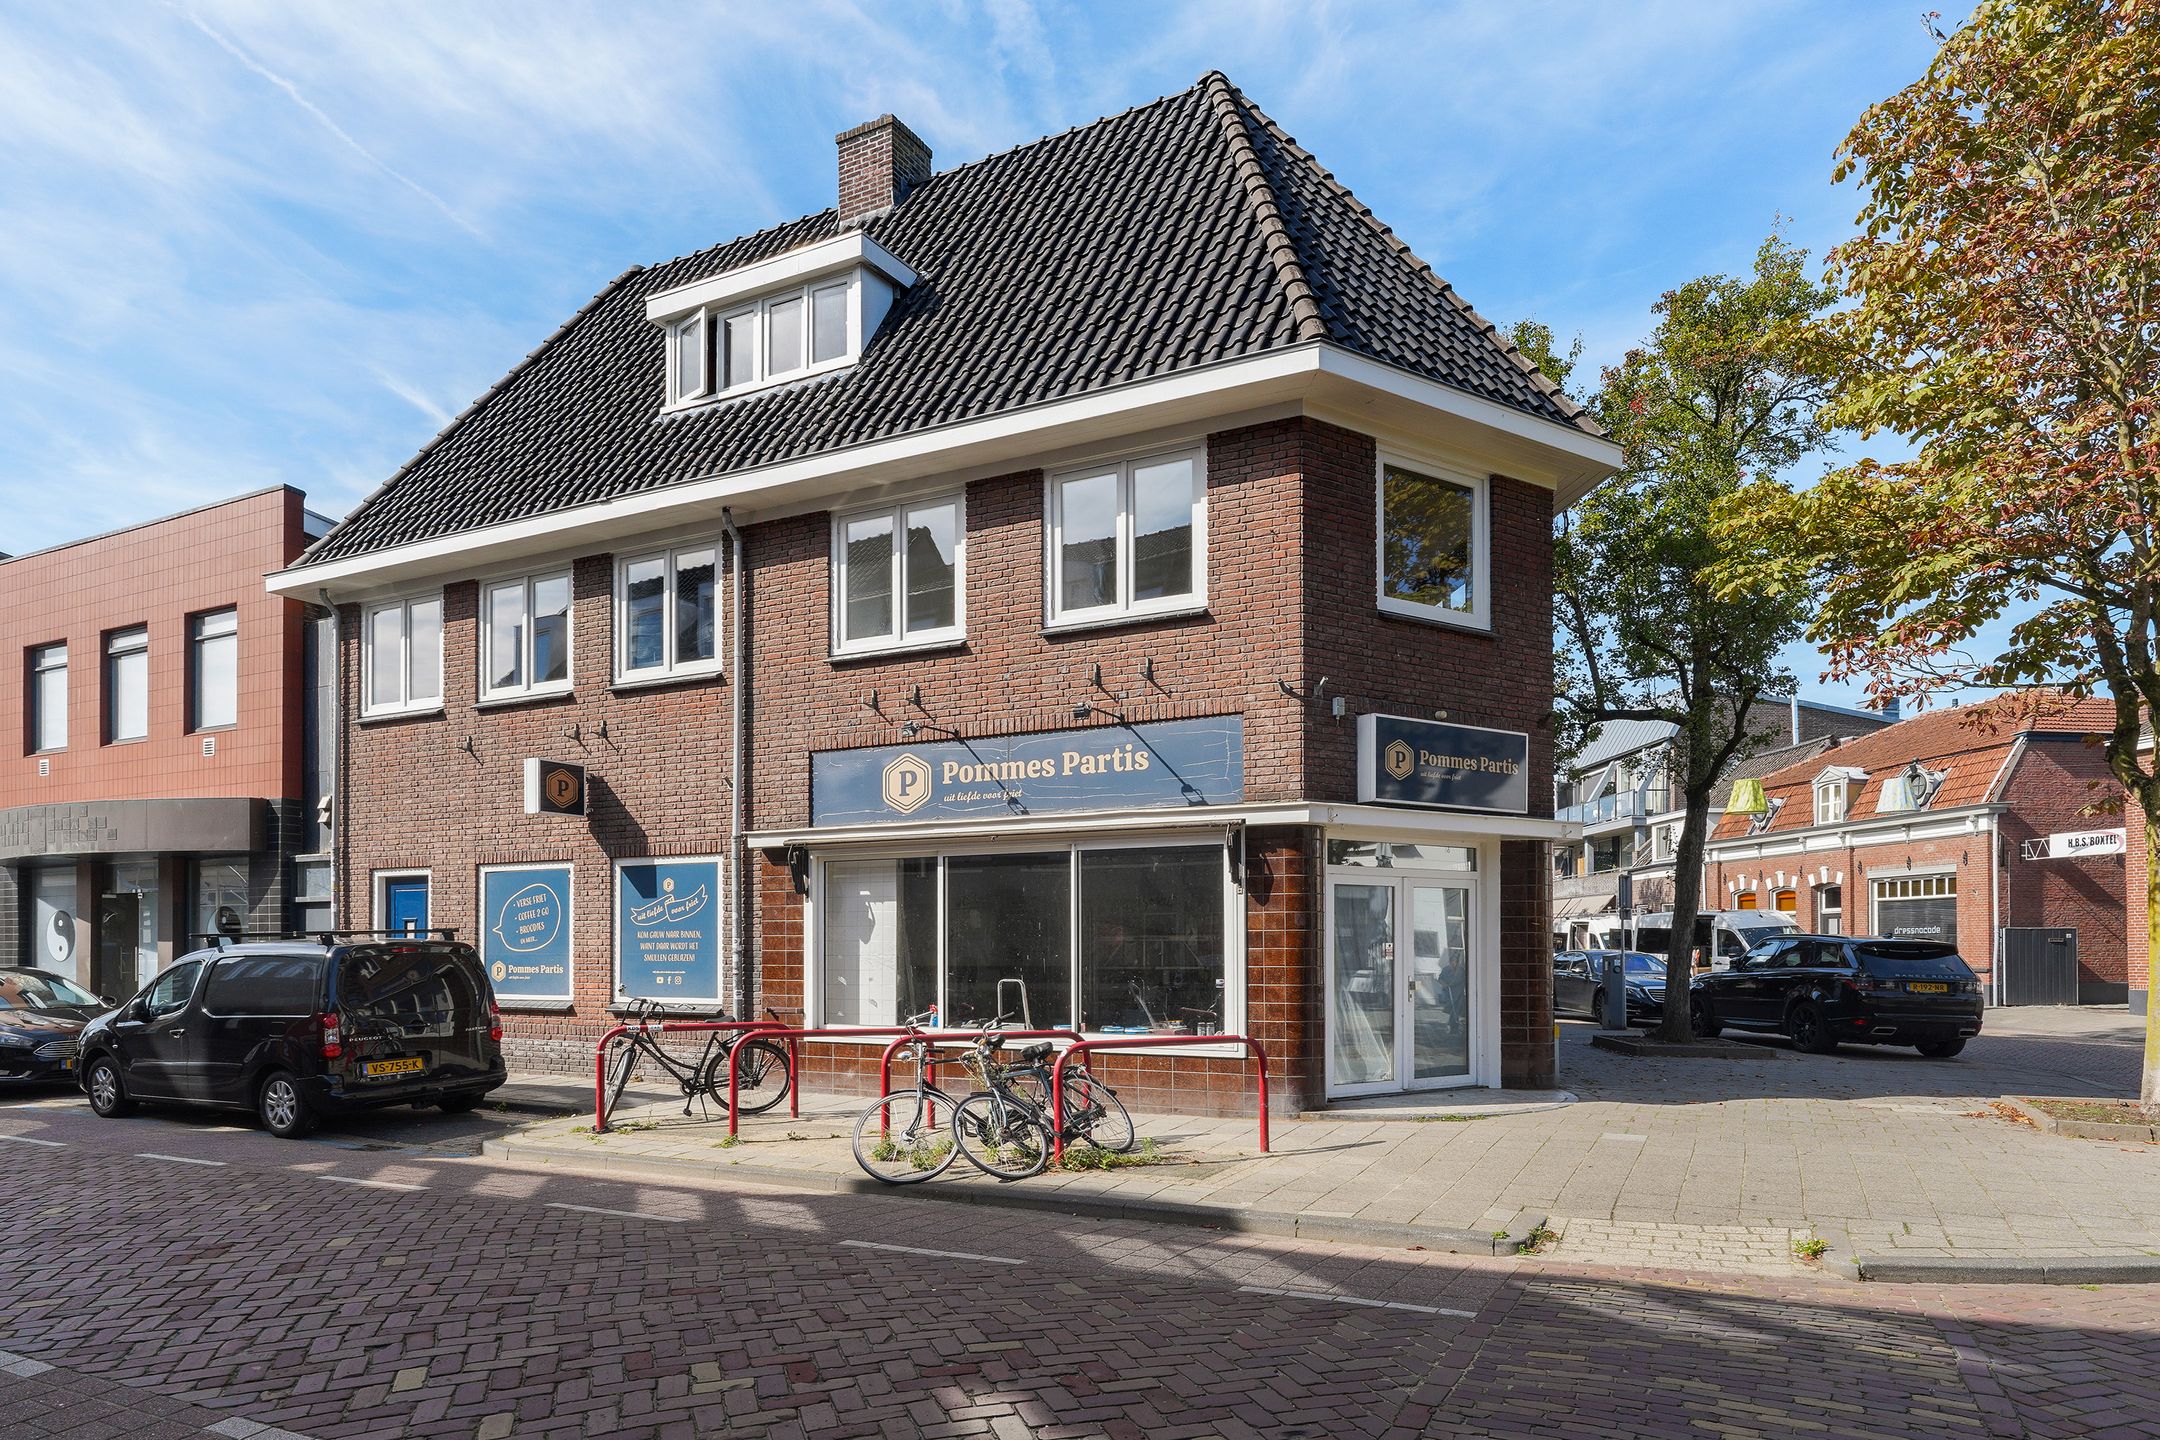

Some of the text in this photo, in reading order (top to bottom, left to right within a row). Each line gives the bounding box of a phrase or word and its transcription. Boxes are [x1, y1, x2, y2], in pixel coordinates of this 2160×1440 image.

[942, 743, 1150, 785] Pommes Partis
[1395, 751, 1406, 768] P
[1419, 750, 1519, 775] Pommes Partis
[557, 779, 570, 797] P
[899, 770, 918, 797] P
[943, 787, 1022, 804] uit liefde voor friet
[2067, 836, 2088, 848] H.B.S.
[666, 881, 672, 889] P
[516, 893, 547, 907] VERSE FRIET
[518, 907, 549, 921] COFFEE 2 GO
[646, 905, 664, 918] liefde
[685, 897, 698, 912] friet
[519, 922, 545, 935] BROODJES
[637, 930, 649, 939] KOM
[650, 930, 664, 939] GAUW
[665, 930, 680, 939] NAAR
[640, 942, 655, 950] WANT
[656, 942, 670, 950] DAAR
[670, 942, 687, 950] WORDT
[643, 953, 667, 962] SMULLEN
[496, 966, 502, 976] P
[508, 963, 564, 974] Pommes Partis
[1913, 983, 1945, 991] R-192-NR
[371, 1060, 419, 1073] VS-755-K
